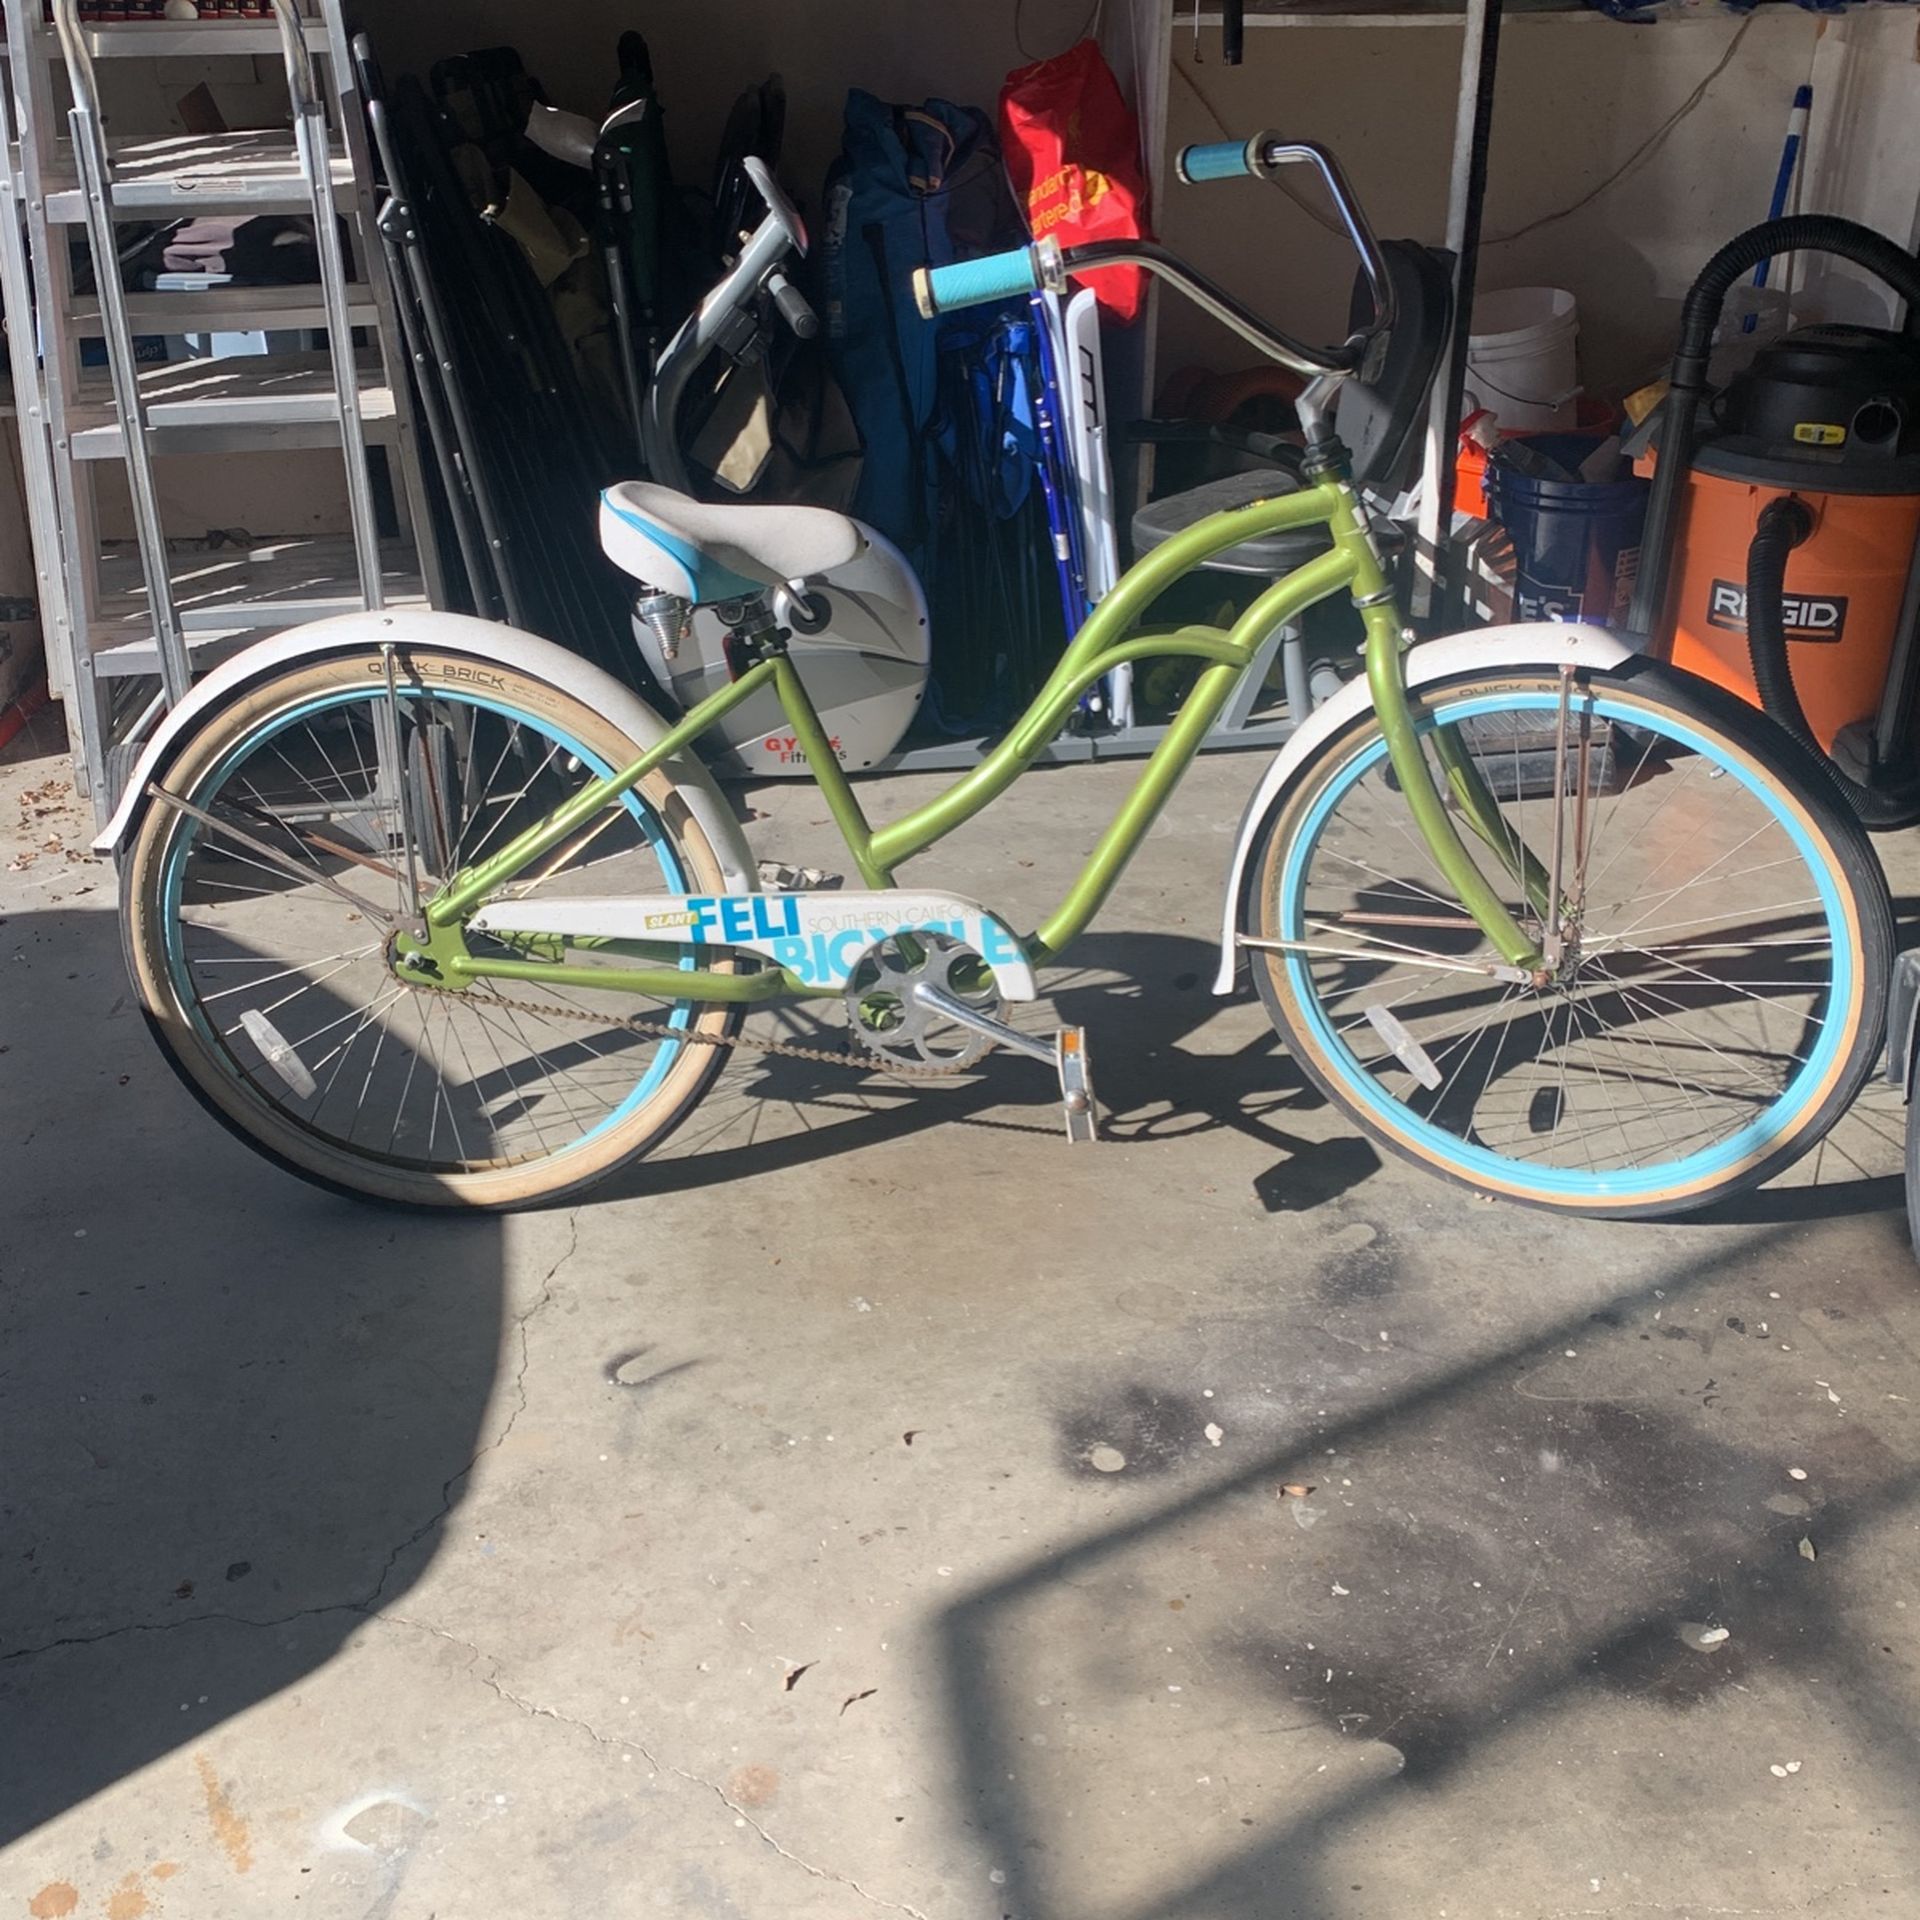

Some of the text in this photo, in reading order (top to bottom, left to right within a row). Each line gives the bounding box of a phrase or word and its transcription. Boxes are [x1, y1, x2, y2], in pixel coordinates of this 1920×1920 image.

[1713, 586, 1840, 628] RIGID
[443, 663, 506, 692] BRICK
[1458, 683, 1523, 697] QUICK
[648, 912, 695, 930] SLANT
[686, 894, 806, 944] FELT
[807, 911, 901, 934] SOUTHERN
